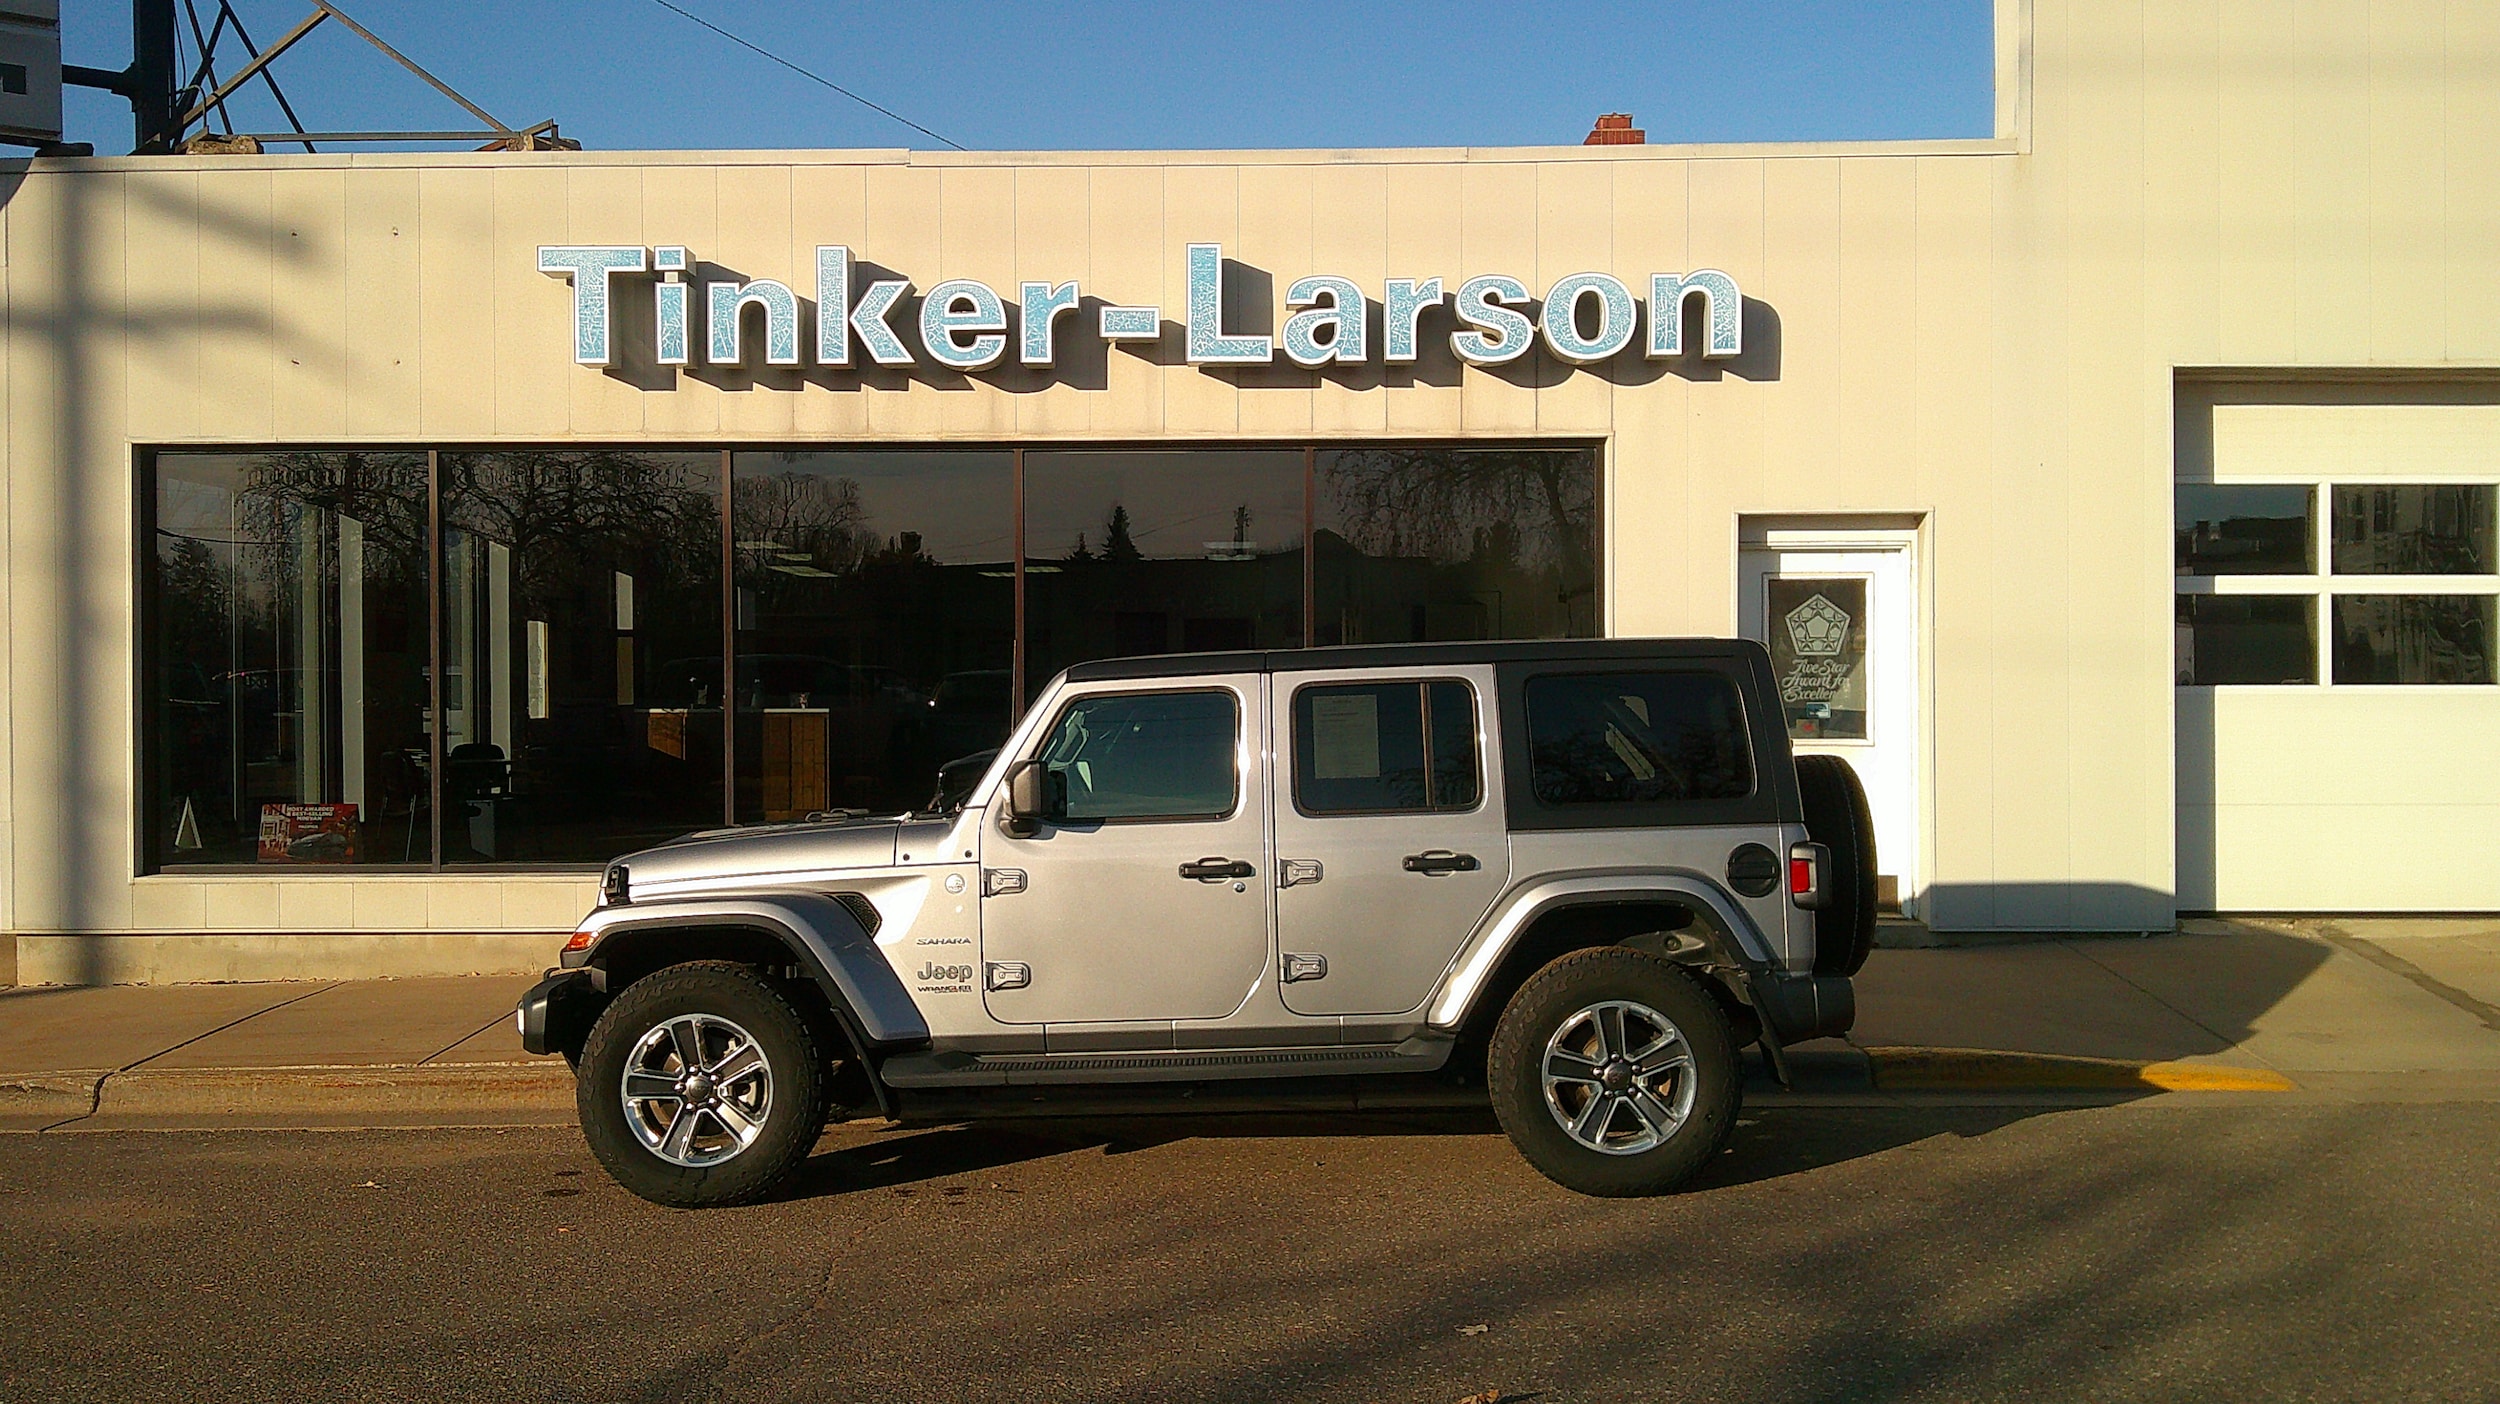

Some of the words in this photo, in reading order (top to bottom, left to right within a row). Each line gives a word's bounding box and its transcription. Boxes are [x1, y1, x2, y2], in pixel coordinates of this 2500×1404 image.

[536, 242, 1743, 371] Tinker-Larson
[1788, 659, 1819, 674] Five
[1819, 659, 1851, 676] Star
[1782, 673, 1831, 689] Award
[917, 961, 973, 983] Jeep
[917, 985, 973, 993] WRANGLER
